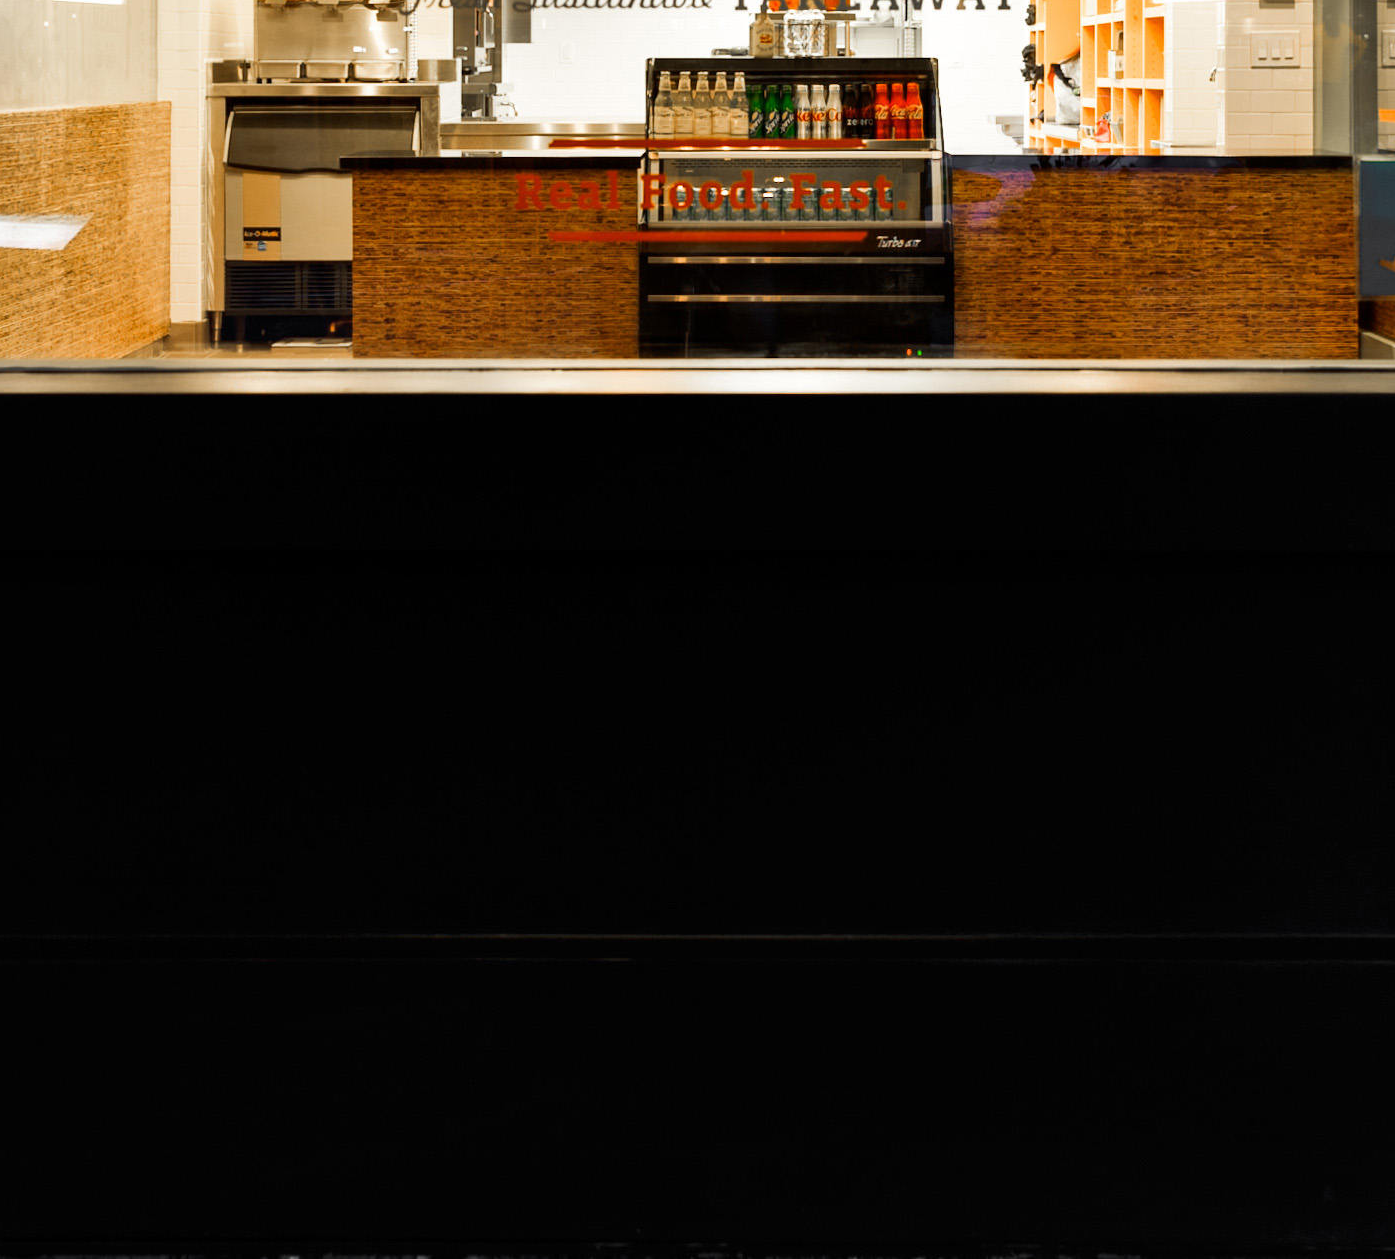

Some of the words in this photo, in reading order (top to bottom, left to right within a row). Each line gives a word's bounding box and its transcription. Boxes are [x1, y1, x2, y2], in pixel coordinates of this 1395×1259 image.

[515, 171, 621, 211] Real
[641, 171, 770, 211] Food.
[789, 172, 908, 211] Fast.
